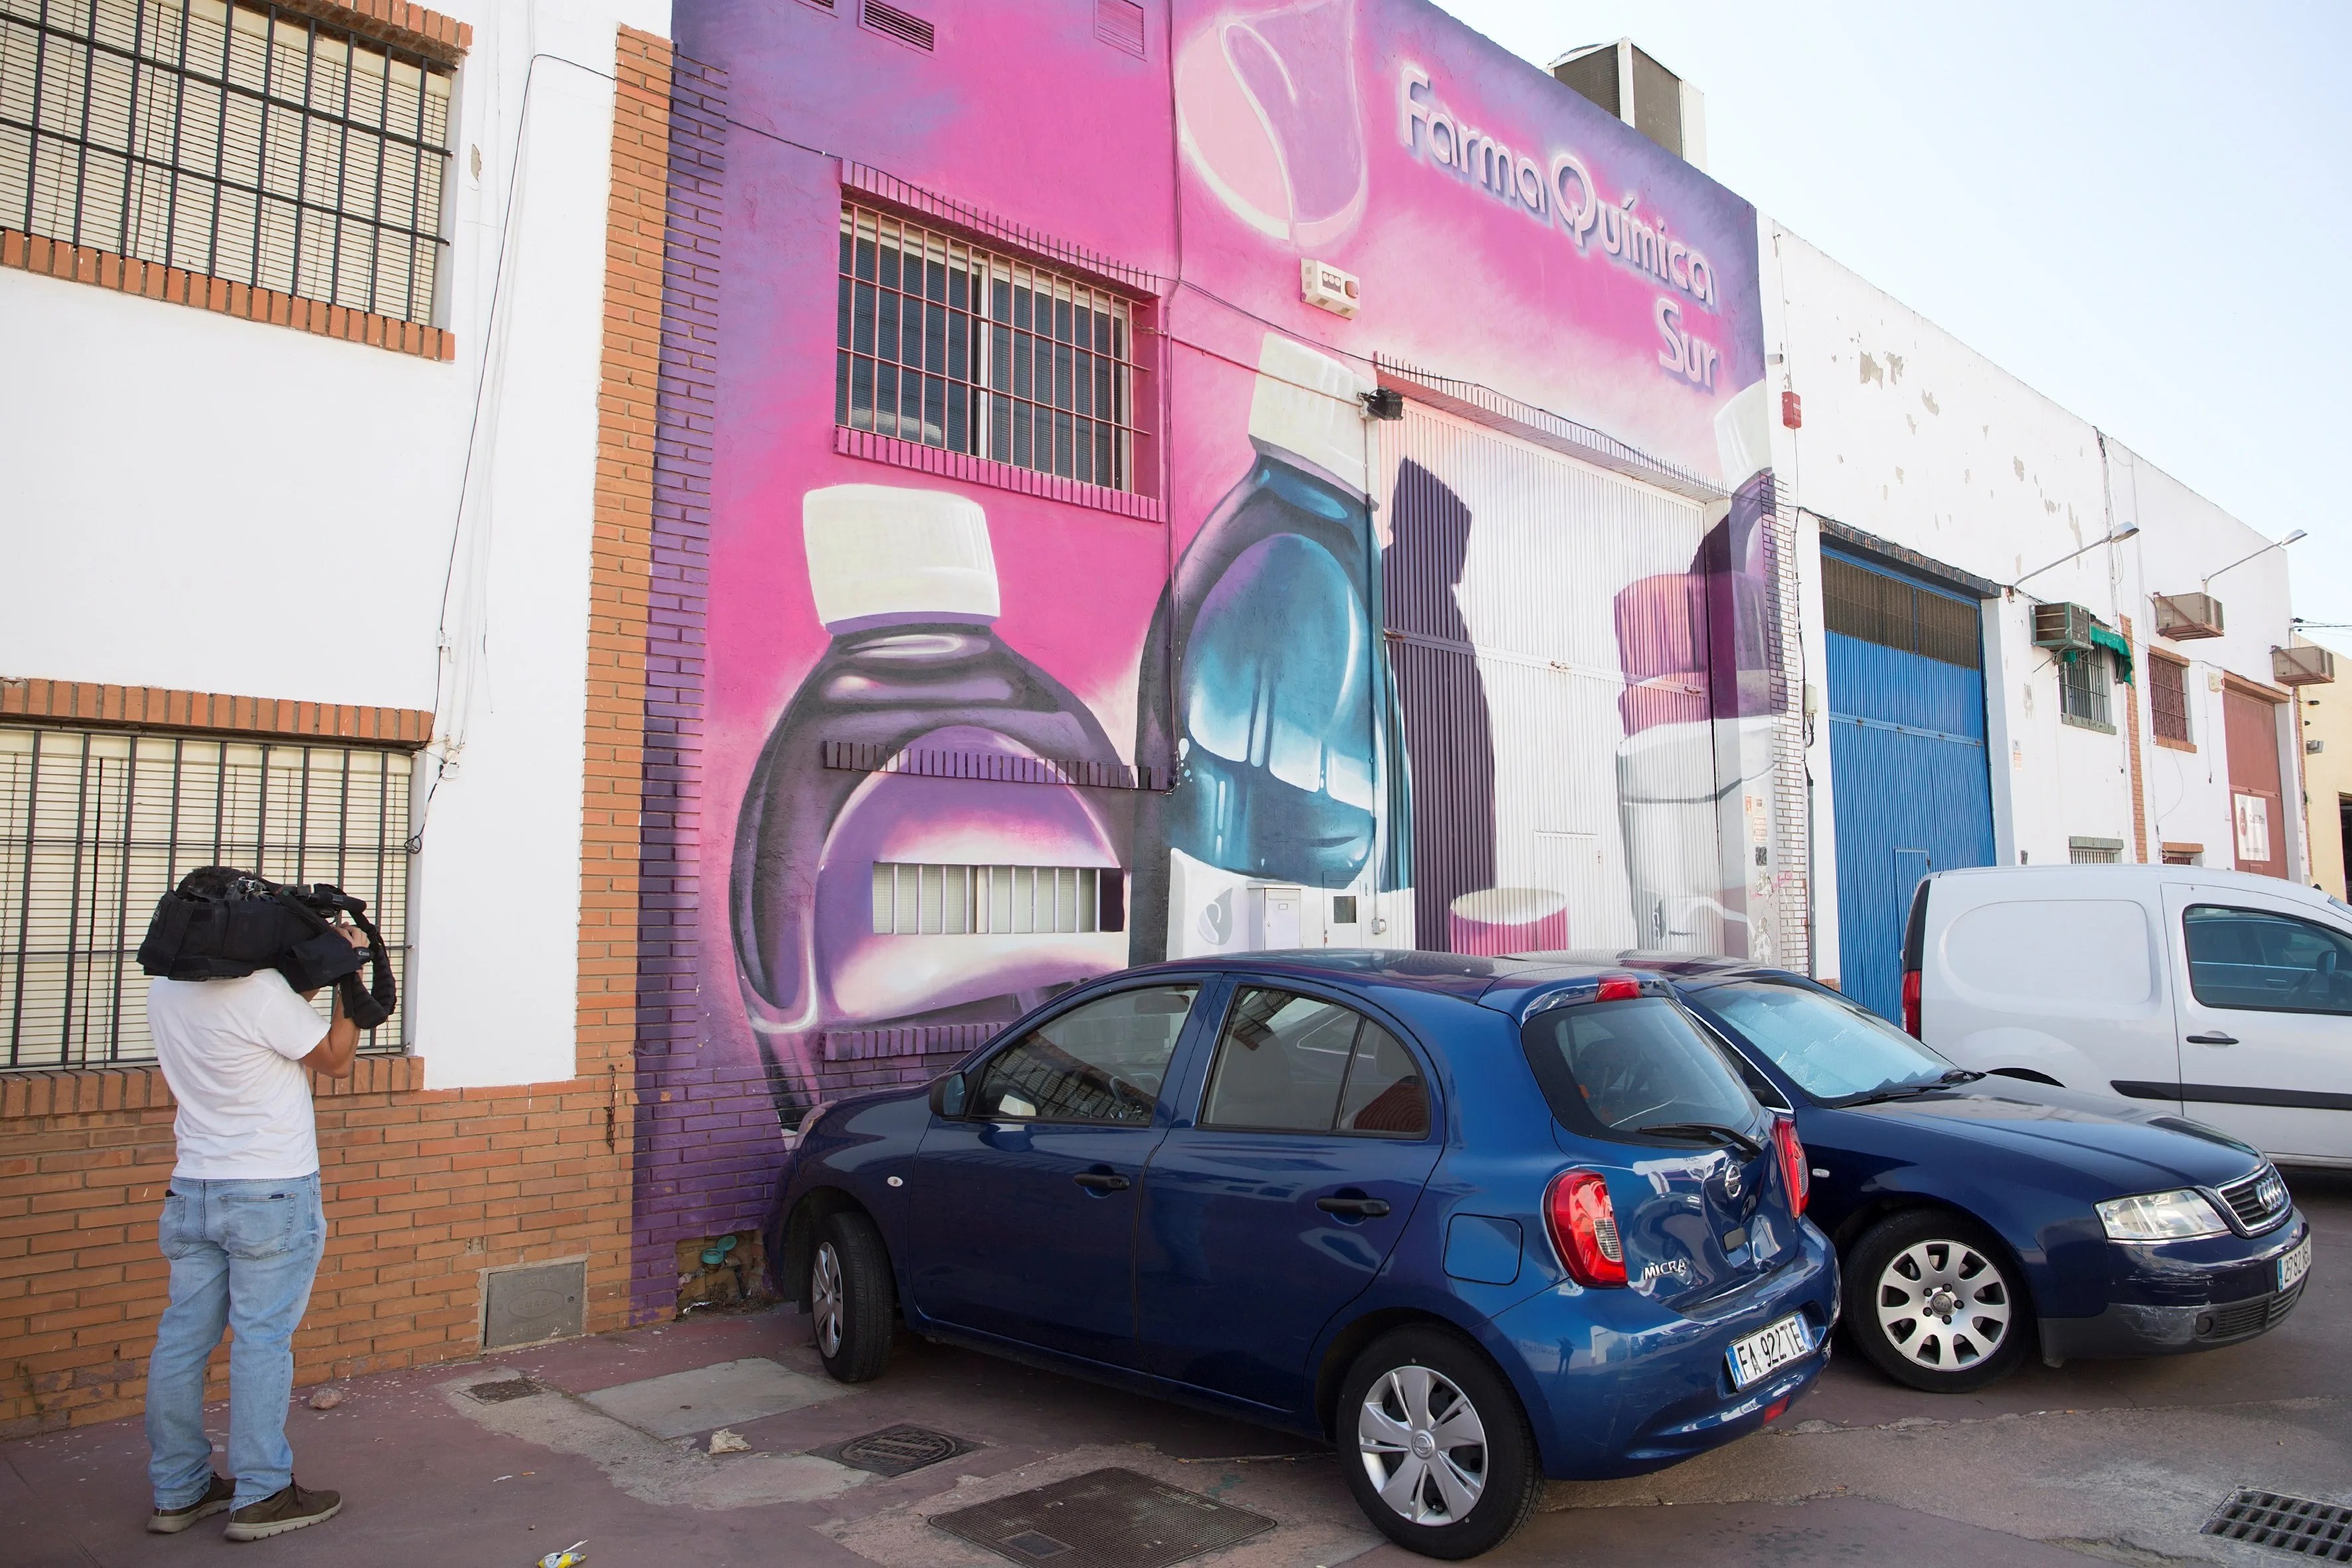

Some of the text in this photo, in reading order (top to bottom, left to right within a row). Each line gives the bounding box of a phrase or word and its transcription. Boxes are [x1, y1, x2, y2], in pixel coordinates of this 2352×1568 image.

[1657, 297, 1717, 387] Sur
[1644, 1259, 1686, 1280] MICRA
[2284, 1250, 2302, 1283] 2782
[1737, 1320, 1806, 1380] FA 922TE
